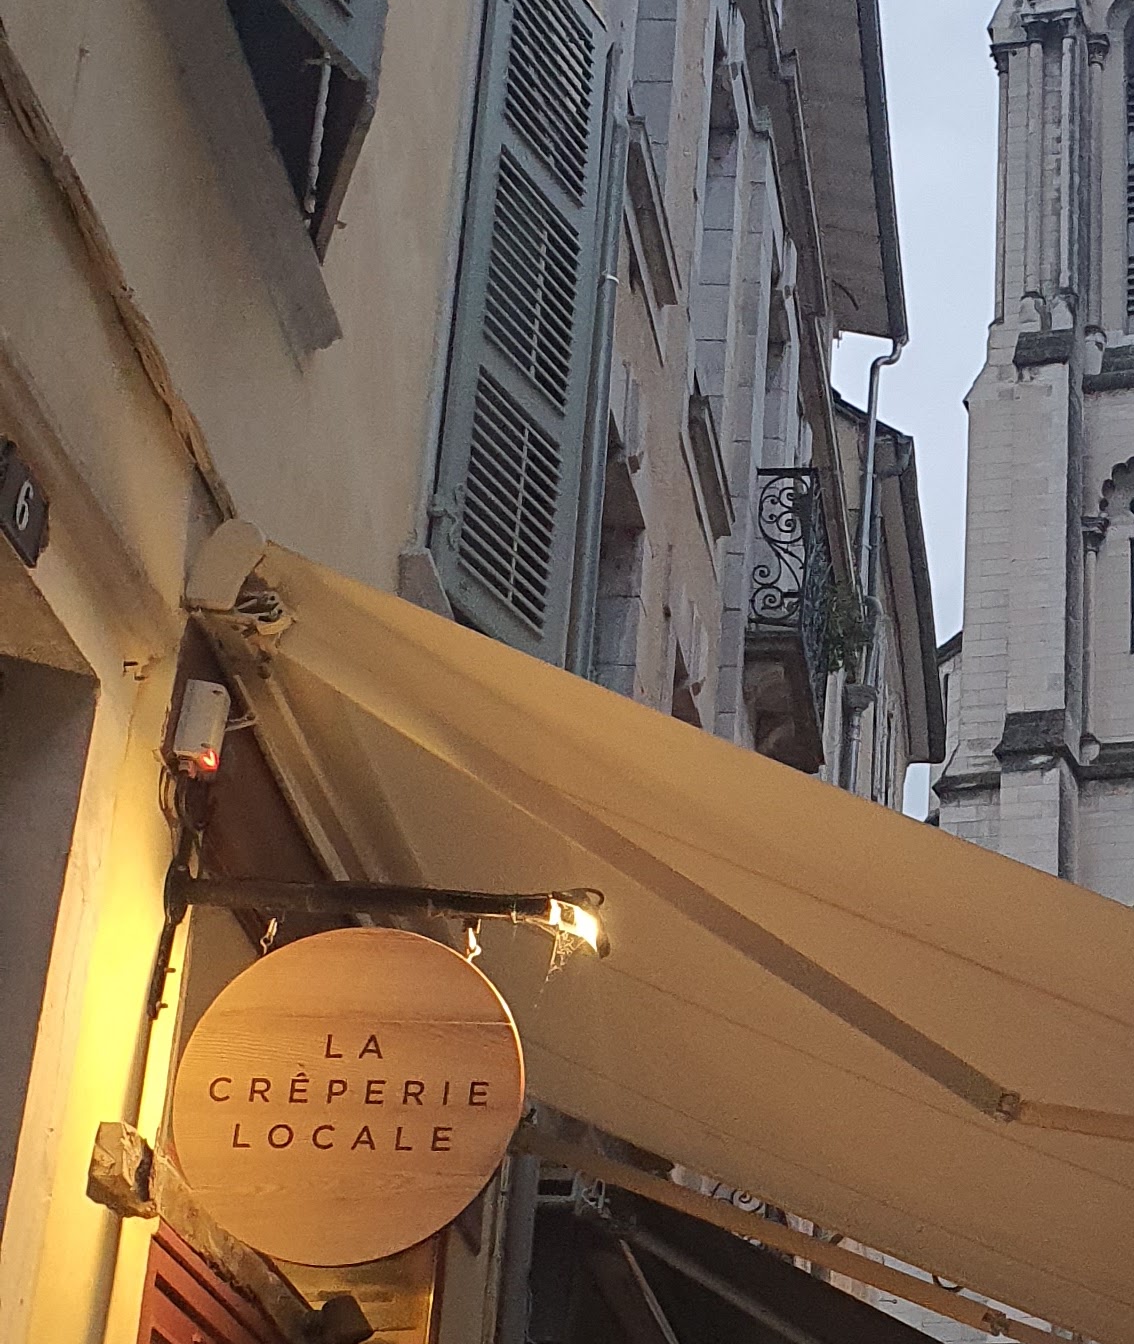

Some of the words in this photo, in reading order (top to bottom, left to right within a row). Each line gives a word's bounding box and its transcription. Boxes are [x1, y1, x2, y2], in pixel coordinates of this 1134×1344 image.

[15, 479, 34, 531] 6
[325, 1034, 384, 1060] LA
[208, 1072, 490, 1107] CRÊPERIE
[232, 1123, 453, 1152] LOCALE
